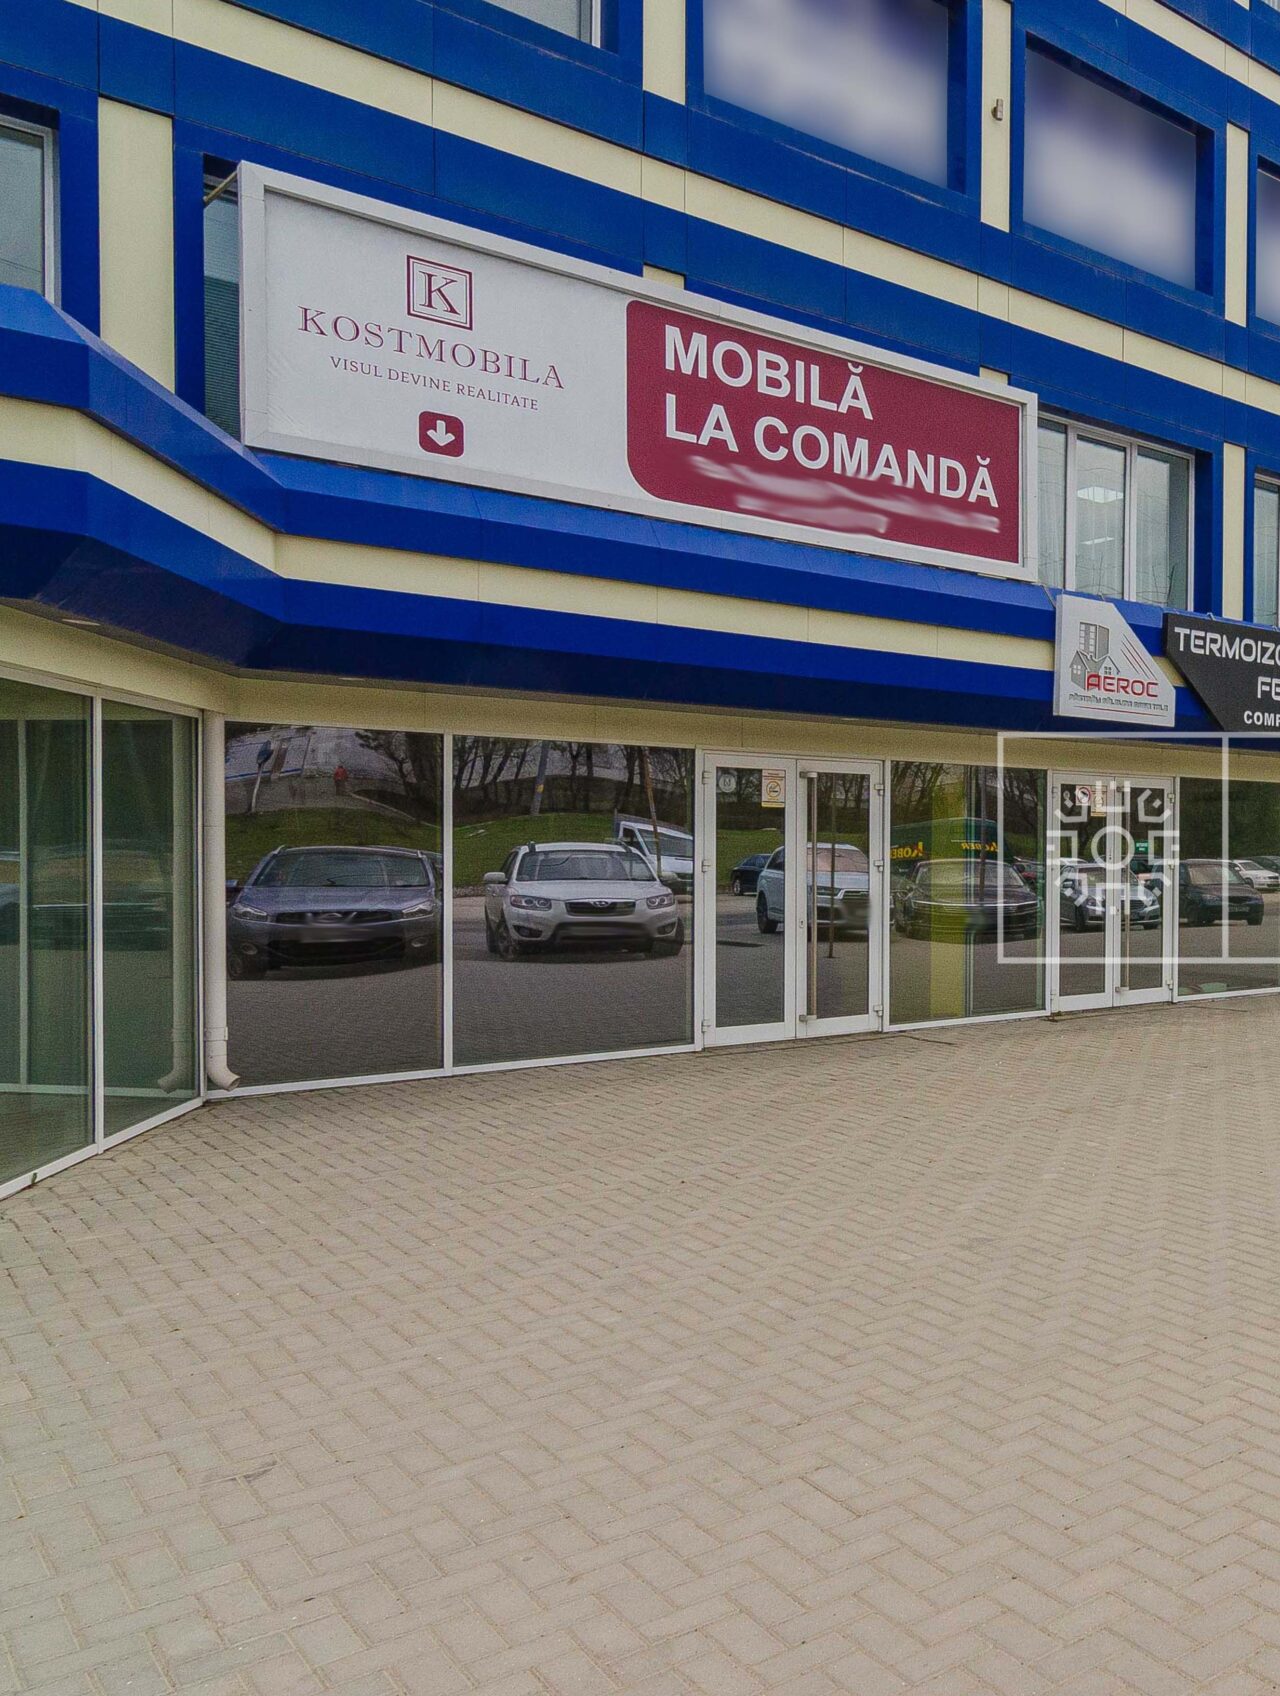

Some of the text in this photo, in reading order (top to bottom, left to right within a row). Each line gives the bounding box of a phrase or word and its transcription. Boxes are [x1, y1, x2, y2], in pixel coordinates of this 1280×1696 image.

[418, 270, 461, 316] K
[297, 305, 565, 390] KOSTMOBILA
[665, 324, 874, 421] MOBILĂ
[330, 356, 539, 411] VISUL DEVINE REALITATE
[666, 393, 739, 453] LA
[754, 416, 999, 508] COMANDĂ
[1087, 673, 1159, 698] AEROC
